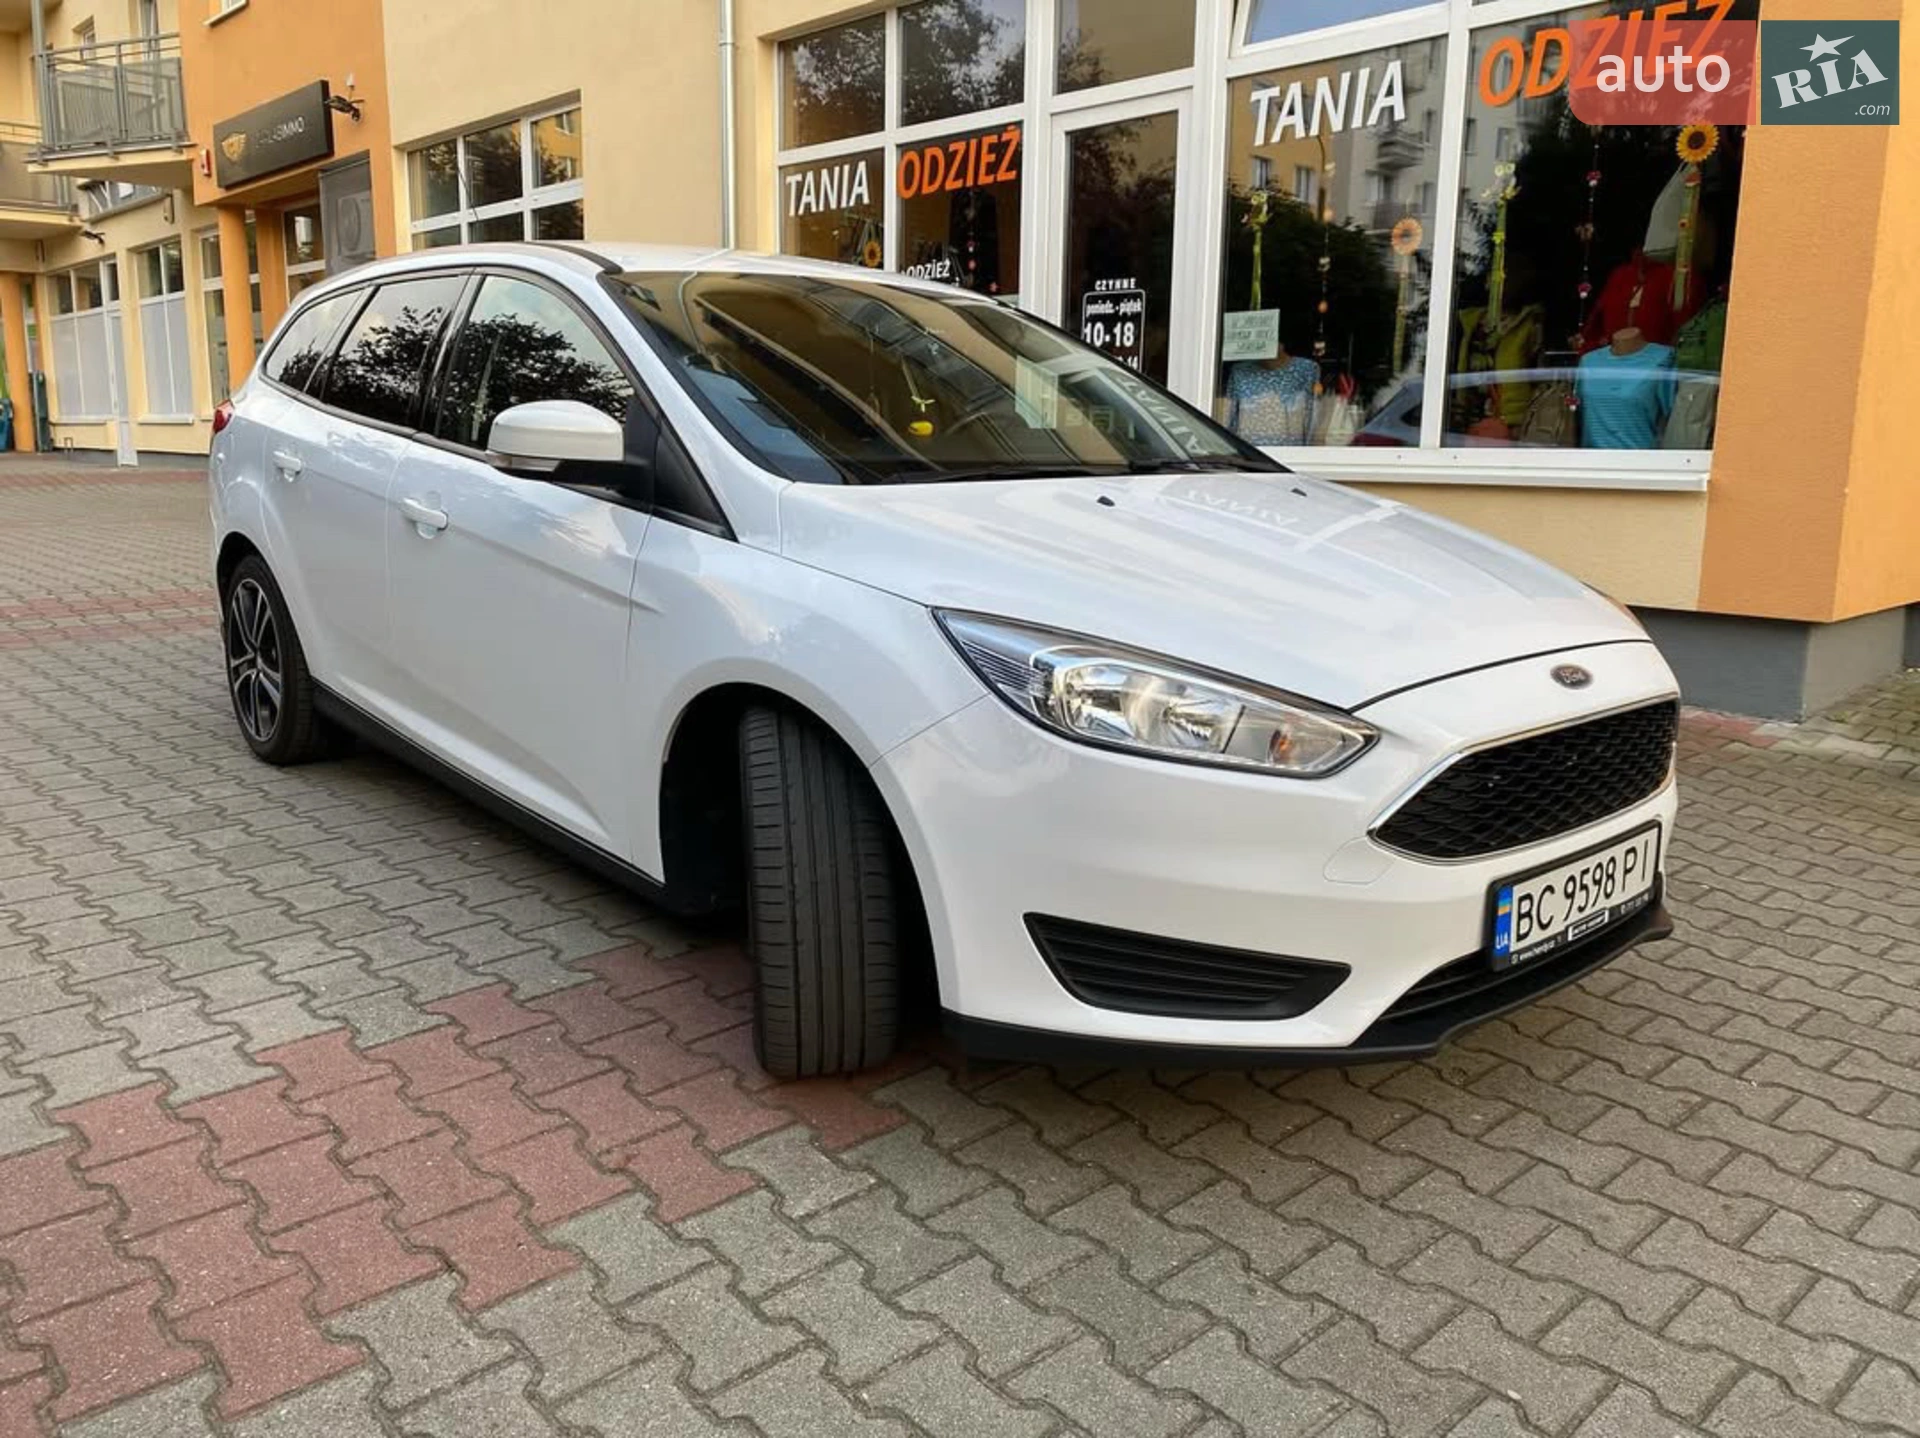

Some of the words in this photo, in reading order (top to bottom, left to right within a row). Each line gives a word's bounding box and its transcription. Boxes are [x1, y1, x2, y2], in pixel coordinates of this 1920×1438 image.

[1250, 60, 1405, 147] TANIA
[785, 160, 870, 217] TANIA
[898, 125, 1021, 199] ODZIEŻ
[1515, 884, 1556, 943] BC
[1563, 855, 1617, 922] 9598
[1621, 838, 1650, 893] PI
[1496, 932, 1510, 950] UA
